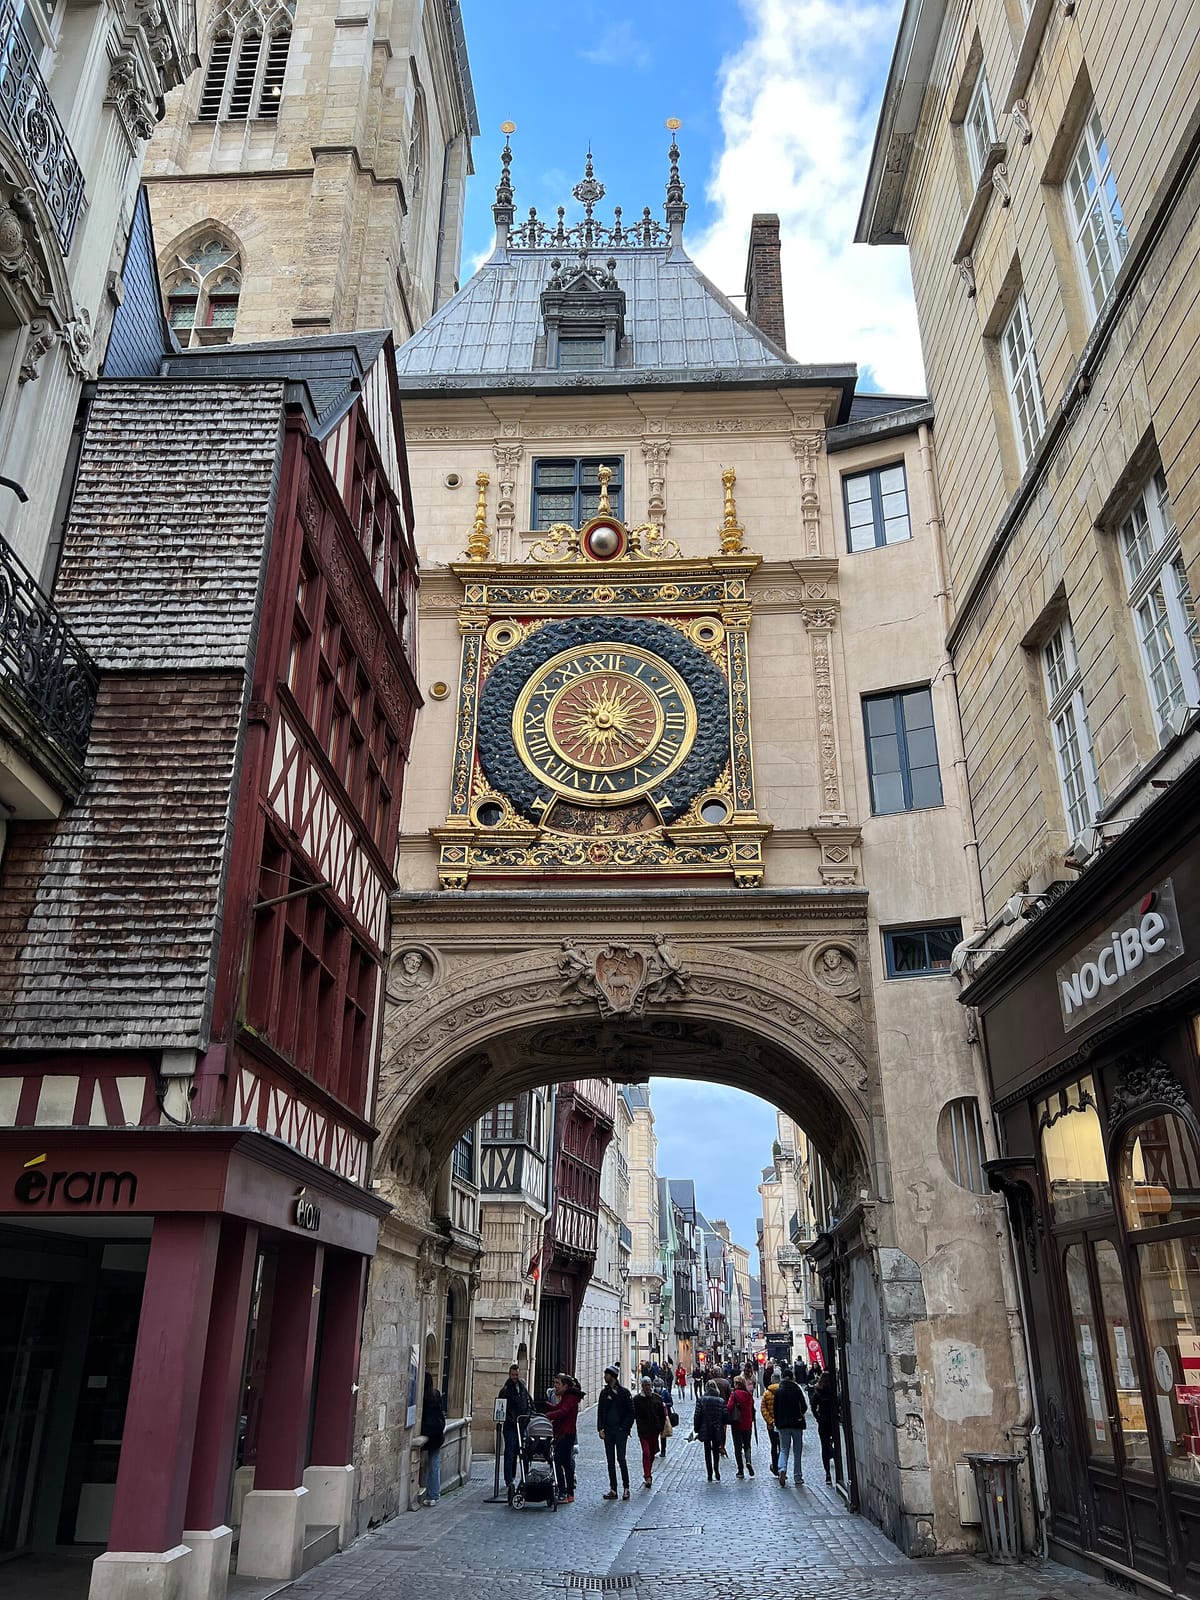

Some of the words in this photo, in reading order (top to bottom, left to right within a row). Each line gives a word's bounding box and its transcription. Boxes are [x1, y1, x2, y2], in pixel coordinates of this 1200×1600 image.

[555, 660, 584, 683] XI
[589, 654, 621, 670] XII
[634, 662, 646, 677] I
[534, 682, 557, 703] X
[654, 684, 676, 699] II
[525, 712, 545, 734] IX
[666, 712, 685, 730] III
[528, 737, 555, 771] VIII
[650, 738, 680, 766] IIII
[551, 766, 580, 789] VII
[590, 774, 617, 791] VI
[634, 767, 652, 785] V
[14, 1153, 138, 1205] éram
